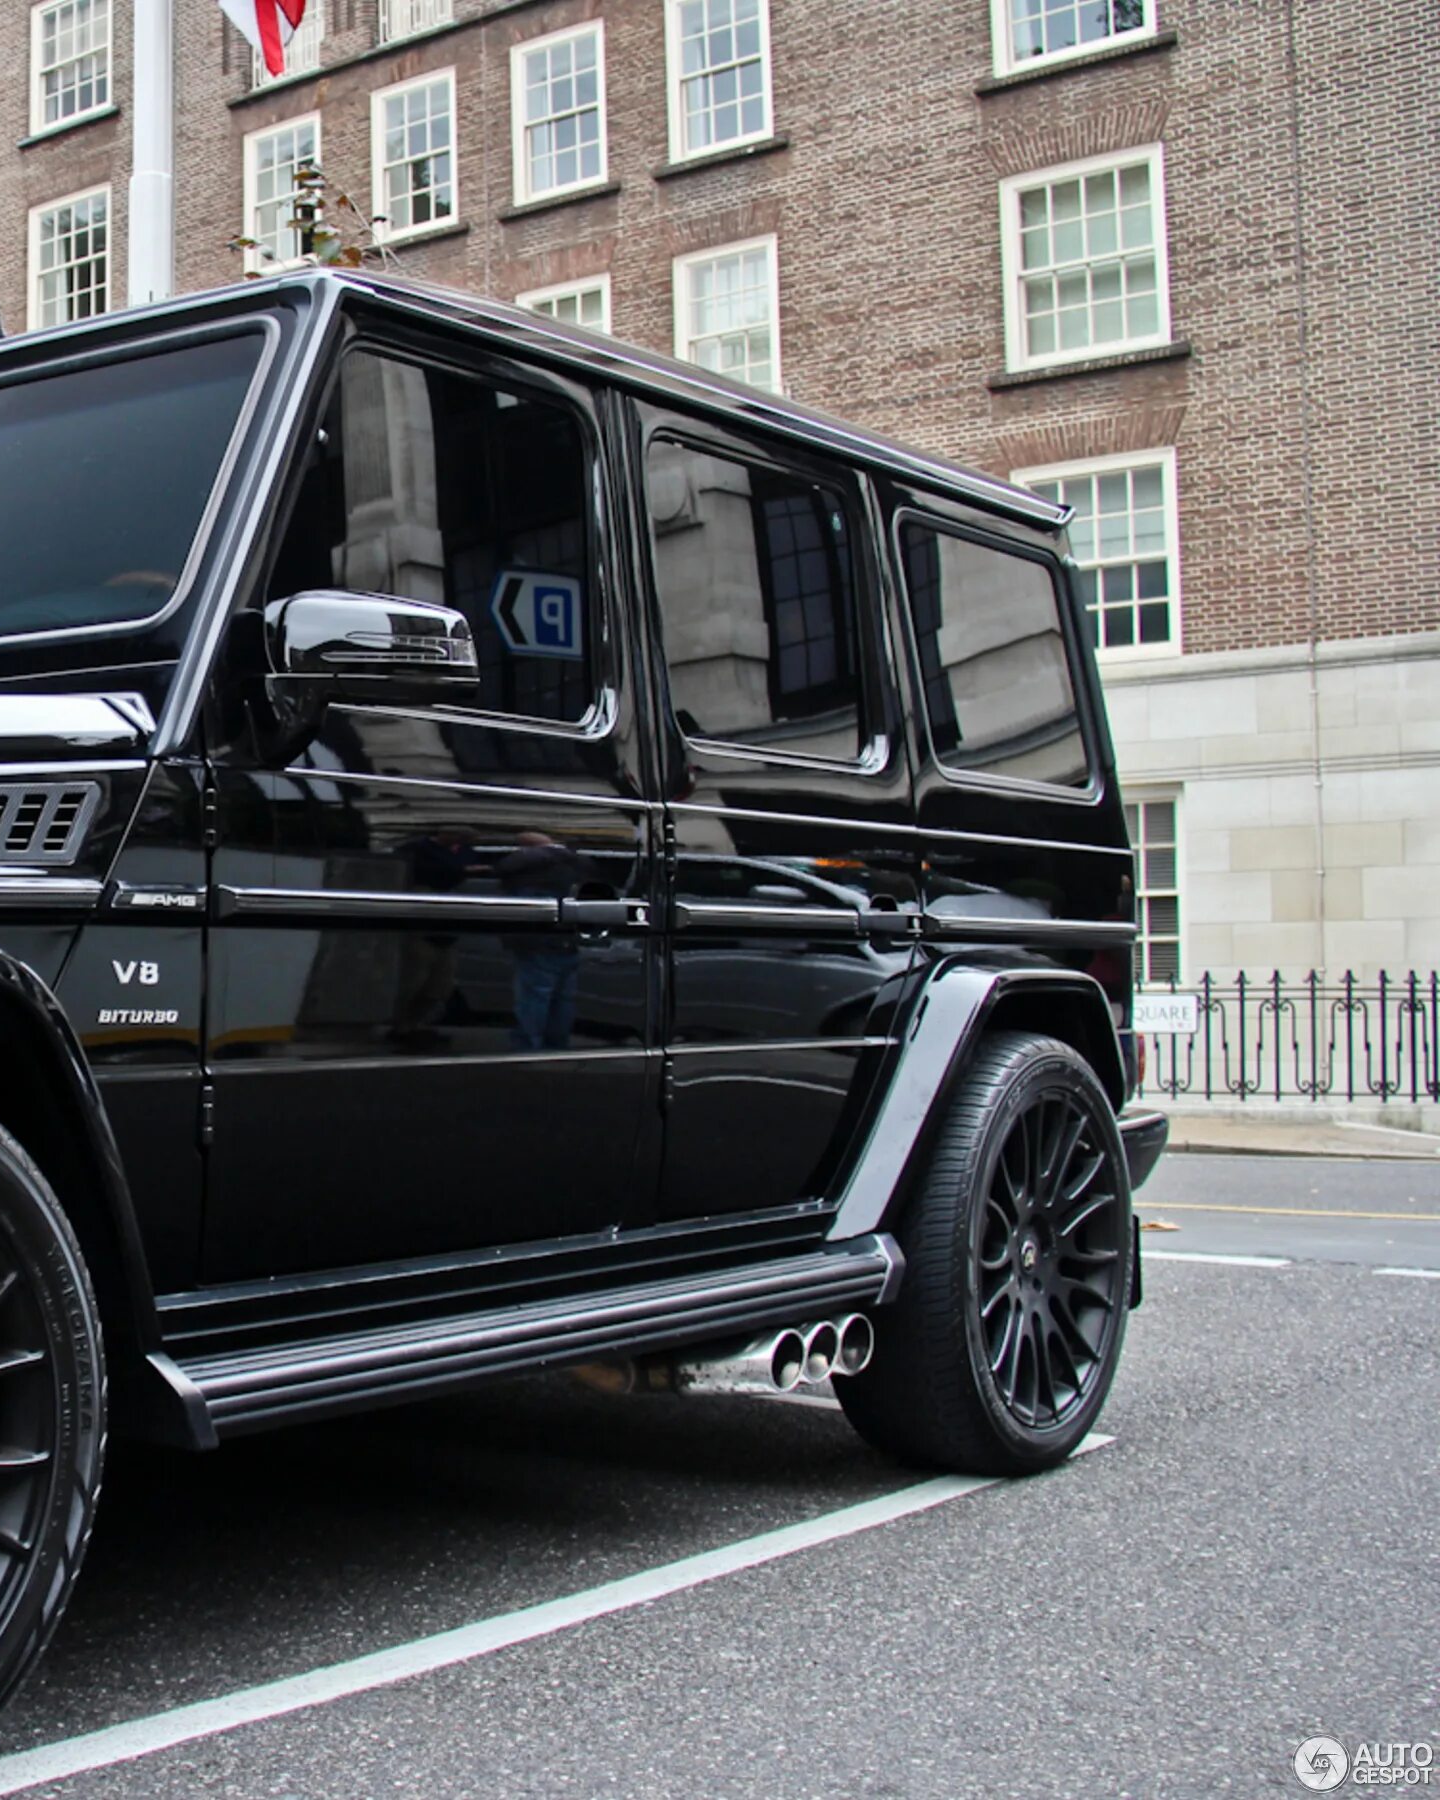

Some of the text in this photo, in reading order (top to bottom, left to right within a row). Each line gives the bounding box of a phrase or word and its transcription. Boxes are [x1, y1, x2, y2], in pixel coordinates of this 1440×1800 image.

[150, 893, 197, 907] AMG
[112, 960, 160, 984] V8
[98, 1009, 179, 1024] BITURBO
[1134, 1005, 1190, 1023] QUARE
